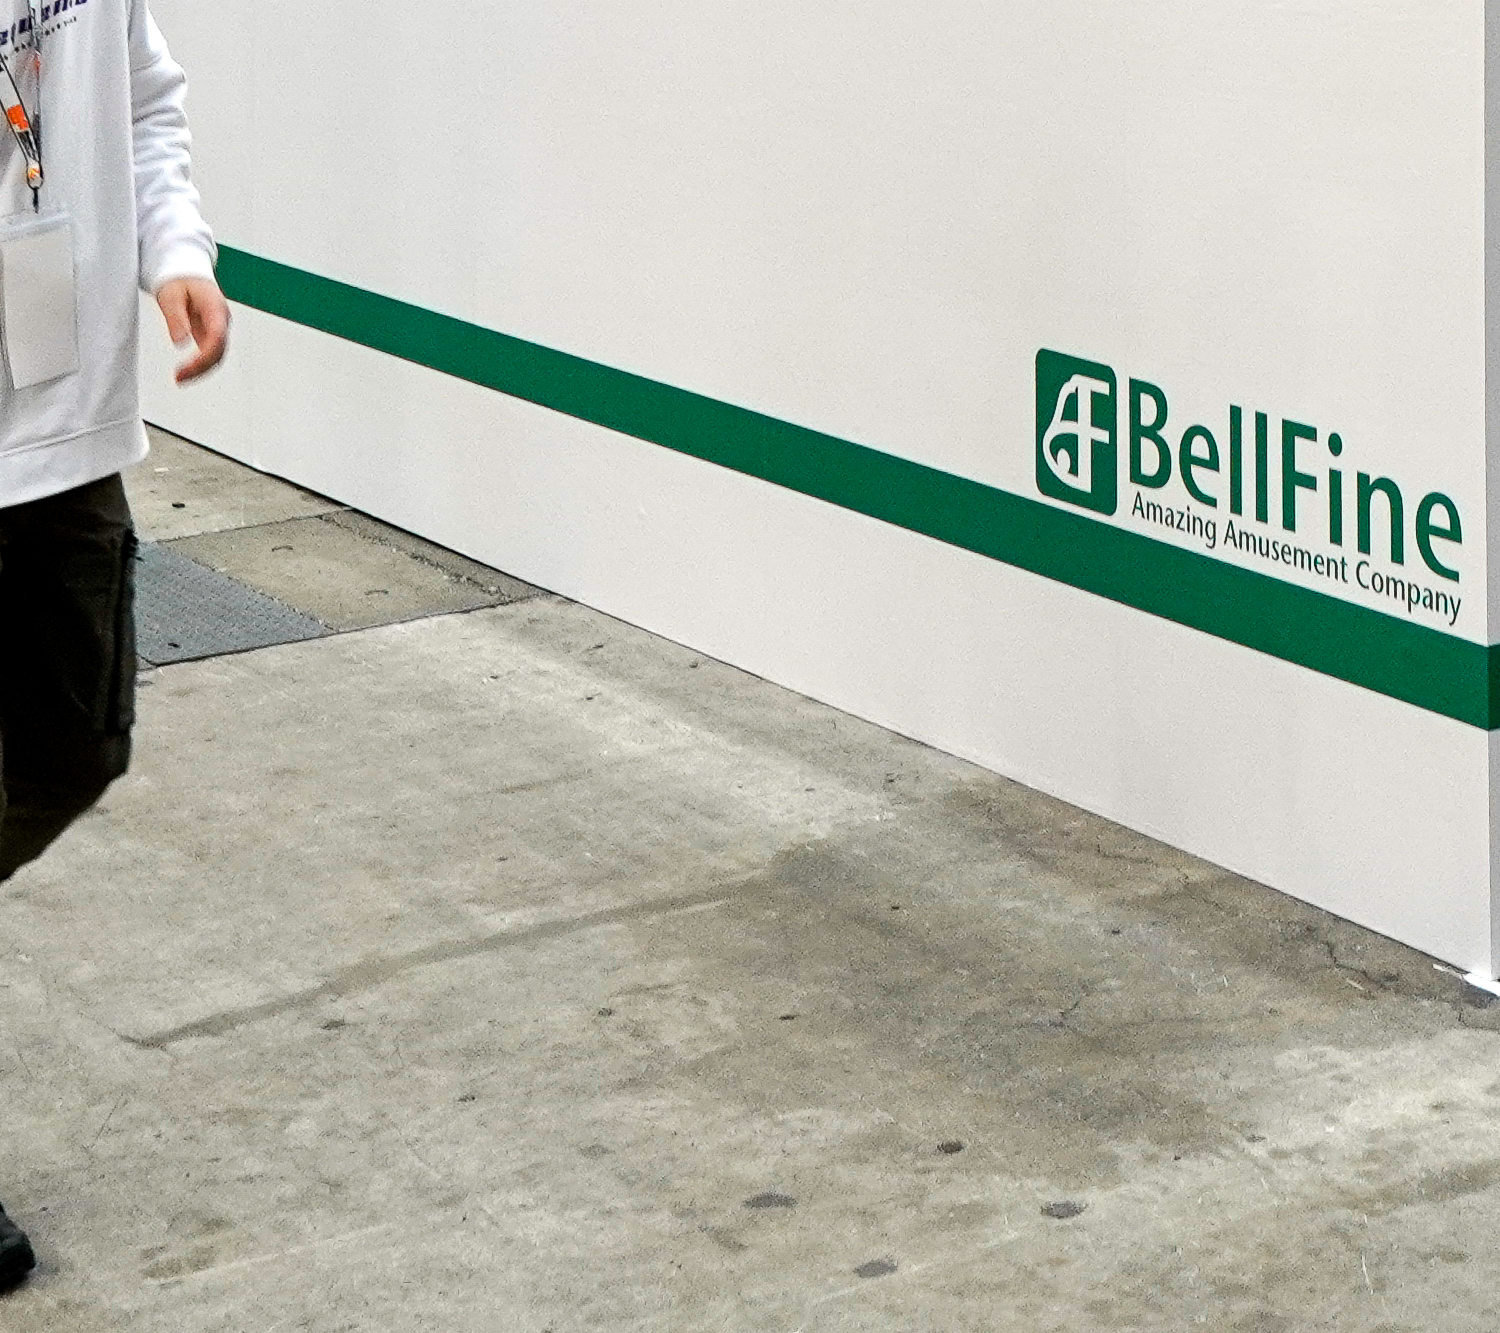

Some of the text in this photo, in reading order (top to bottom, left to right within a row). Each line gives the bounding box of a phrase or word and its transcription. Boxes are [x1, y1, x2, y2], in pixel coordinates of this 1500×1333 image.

[1128, 376, 1464, 584] BellFine
[1131, 490, 1462, 627] Amazing Amusement Company
